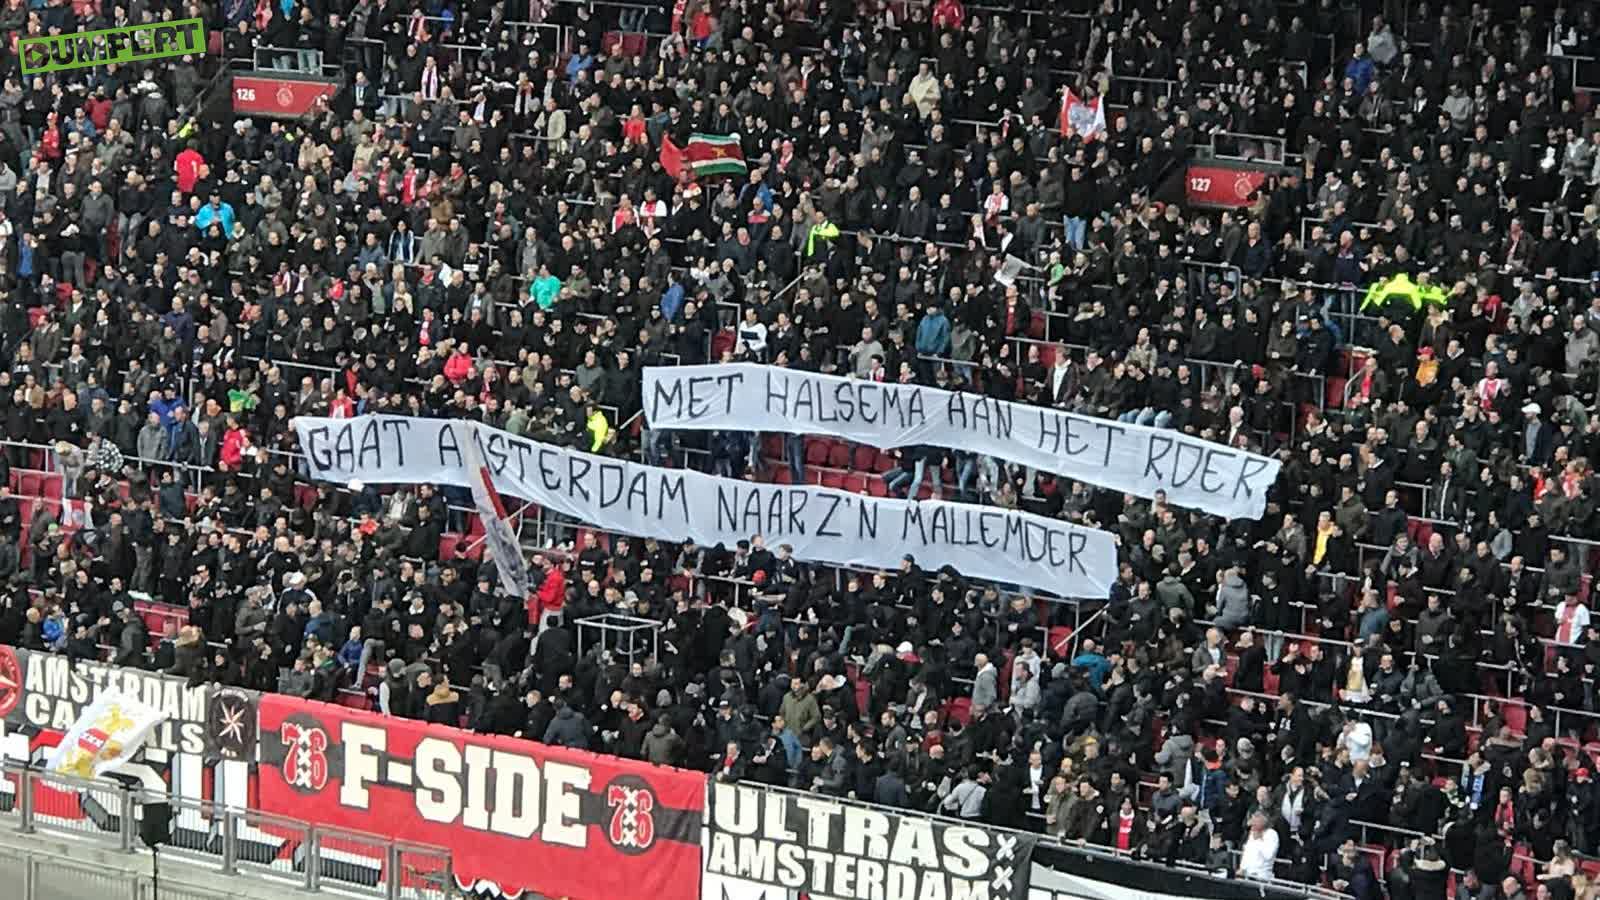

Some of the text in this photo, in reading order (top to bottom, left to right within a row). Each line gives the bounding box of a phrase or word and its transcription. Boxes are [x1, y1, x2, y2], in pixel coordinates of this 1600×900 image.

[236, 87, 256, 101] 126
[1191, 177, 1211, 192] 127
[652, 373, 744, 423] MET
[766, 371, 926, 428] HALSEMA
[948, 390, 1013, 440] AAN
[1038, 410, 1125, 467] HET
[308, 419, 411, 473] GAAT
[716, 485, 808, 536] NAAR
[340, 722, 593, 848] F-SIDE
[713, 782, 991, 877] ULTRAS
